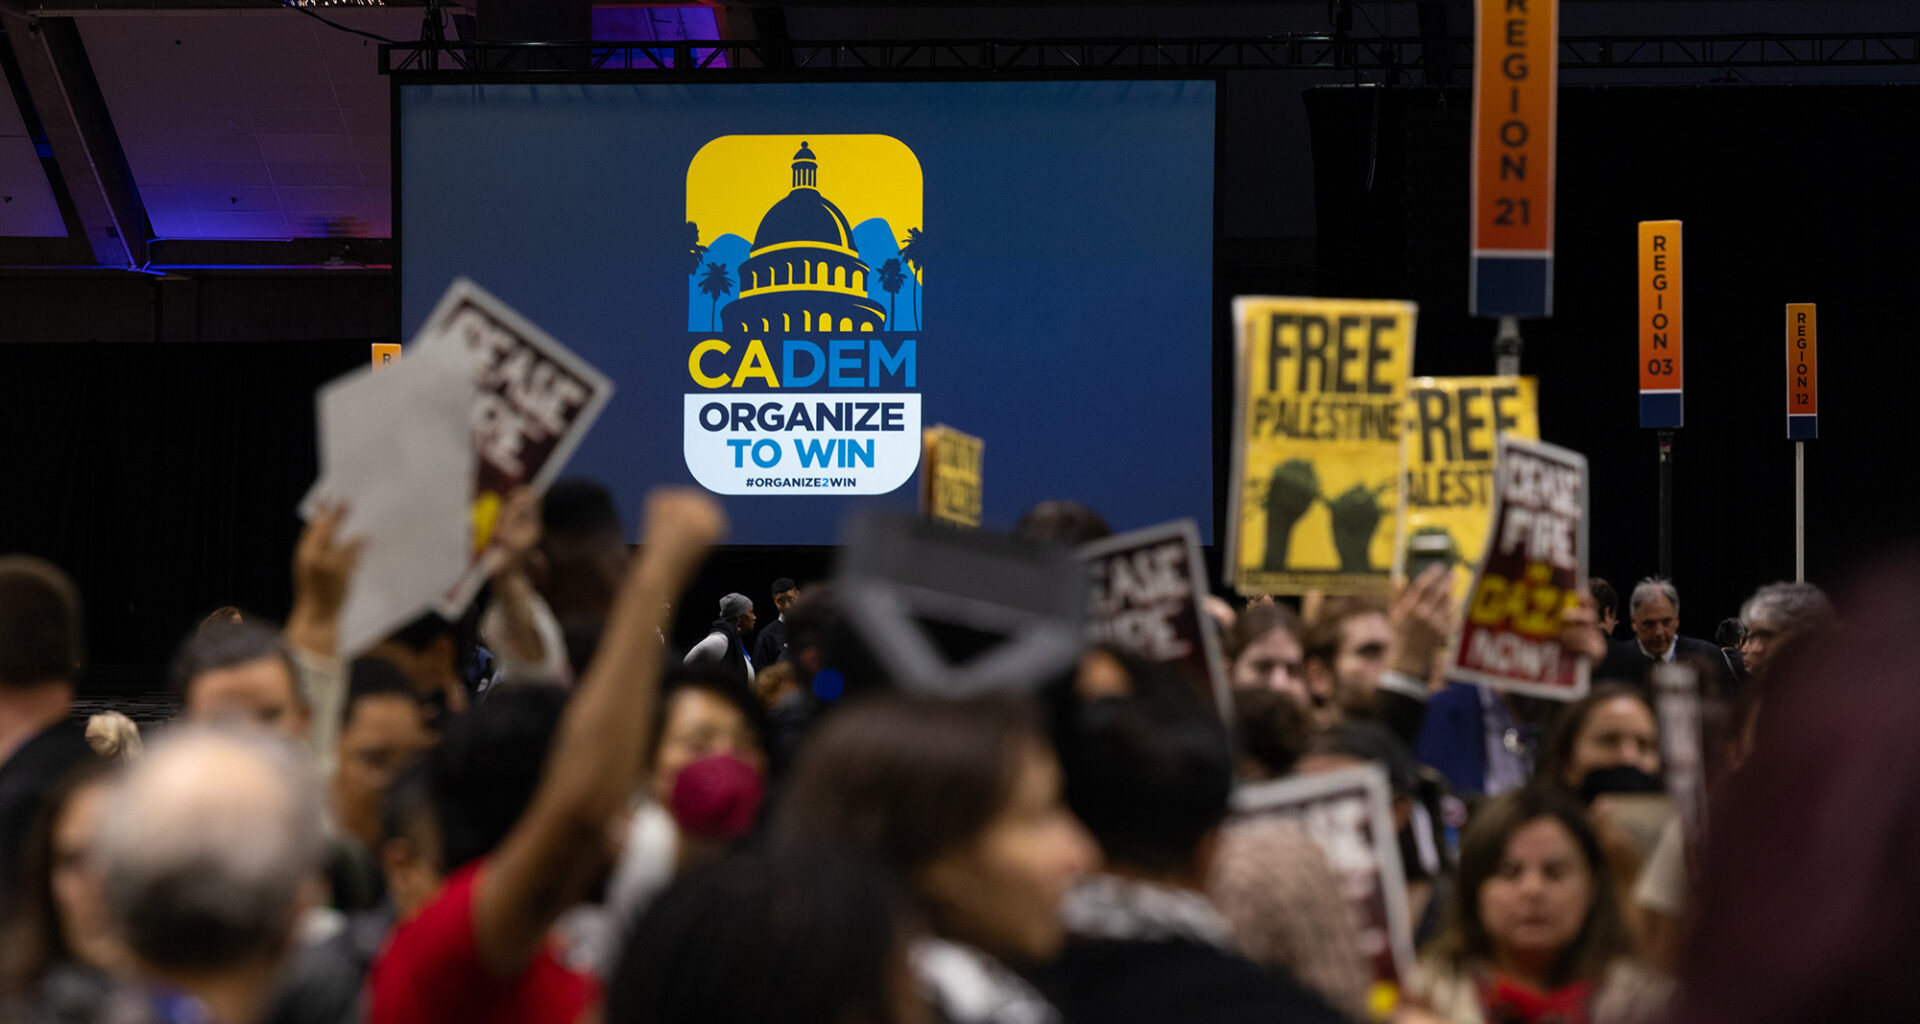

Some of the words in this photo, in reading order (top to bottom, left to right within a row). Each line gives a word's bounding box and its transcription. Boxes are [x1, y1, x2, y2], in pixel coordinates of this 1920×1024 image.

[1494, 198, 1531, 226] 21
[1652, 235, 1668, 350] REGION
[688, 338, 917, 389] CADEM
[1267, 312, 1397, 395] FREE
[1647, 358, 1674, 376] 03
[1796, 312, 1809, 388] REGION
[698, 401, 905, 433] ORGANIZE
[1252, 396, 1402, 443] PALESTINE
[1408, 387, 1518, 462] REE
[1795, 393, 1809, 405] 12
[726, 438, 782, 469] TO
[793, 438, 875, 469] WIN
[745, 477, 857, 488] #ORGANIZE2WIN
[1501, 452, 1582, 521] CEASE
[1501, 506, 1579, 571] FIRE
[1092, 544, 1192, 604] EASE
